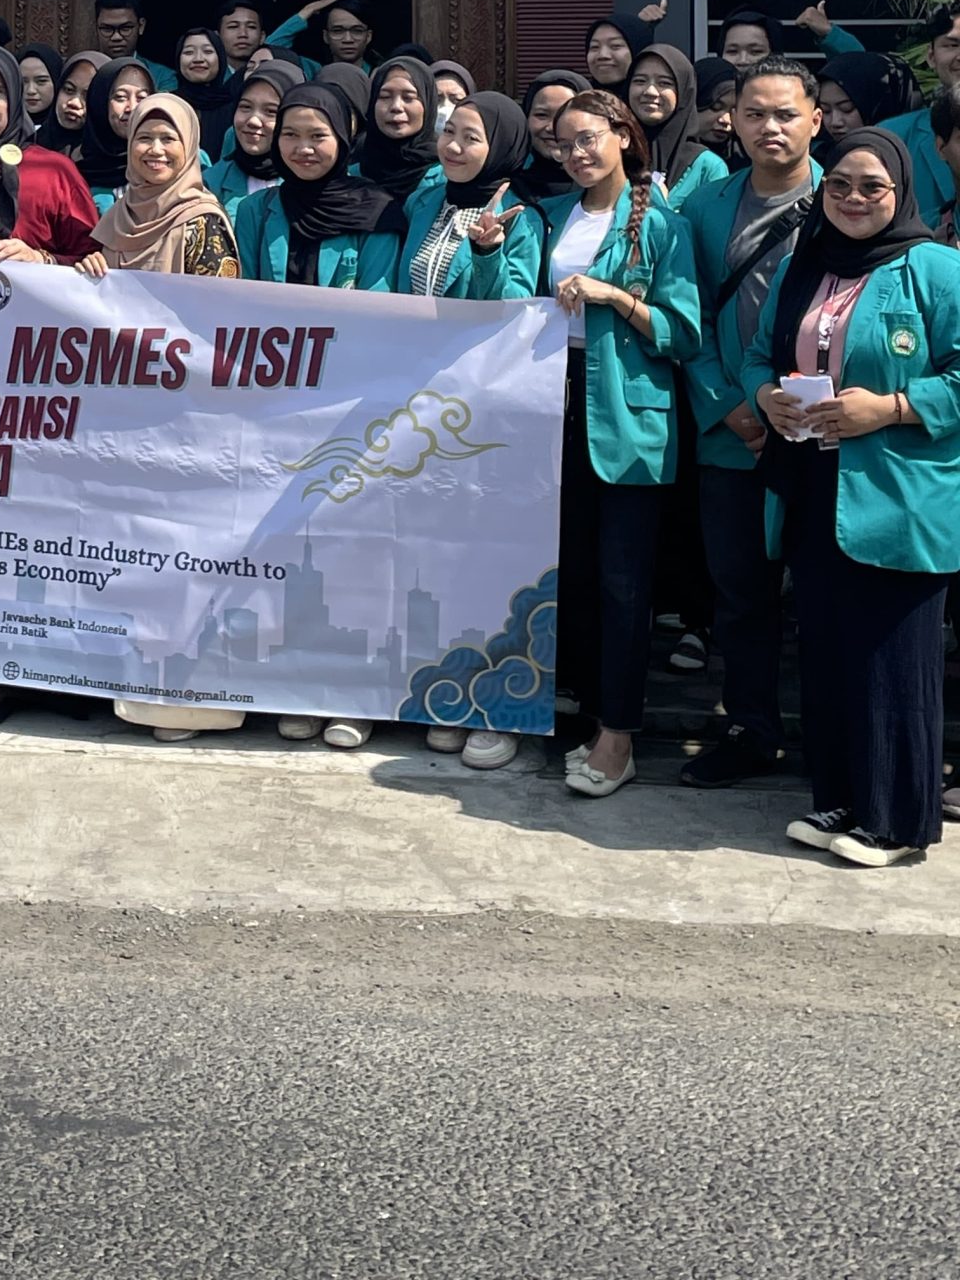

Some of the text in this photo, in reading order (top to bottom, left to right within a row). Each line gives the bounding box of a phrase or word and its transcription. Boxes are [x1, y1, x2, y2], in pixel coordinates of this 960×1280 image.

[6, 327, 193, 391] MSMEs
[211, 326, 336, 388] VISIT
[12, 558, 121, 591] Economy”
[33, 536, 73, 558] and
[77, 539, 170, 572] Industry
[174, 551, 258, 579] Growth
[262, 561, 287, 580] to
[2, 611, 47, 626] Javasche
[49, 616, 76, 629] Bank
[77, 620, 128, 636] Indonesia
[21, 625, 48, 639] Batik
